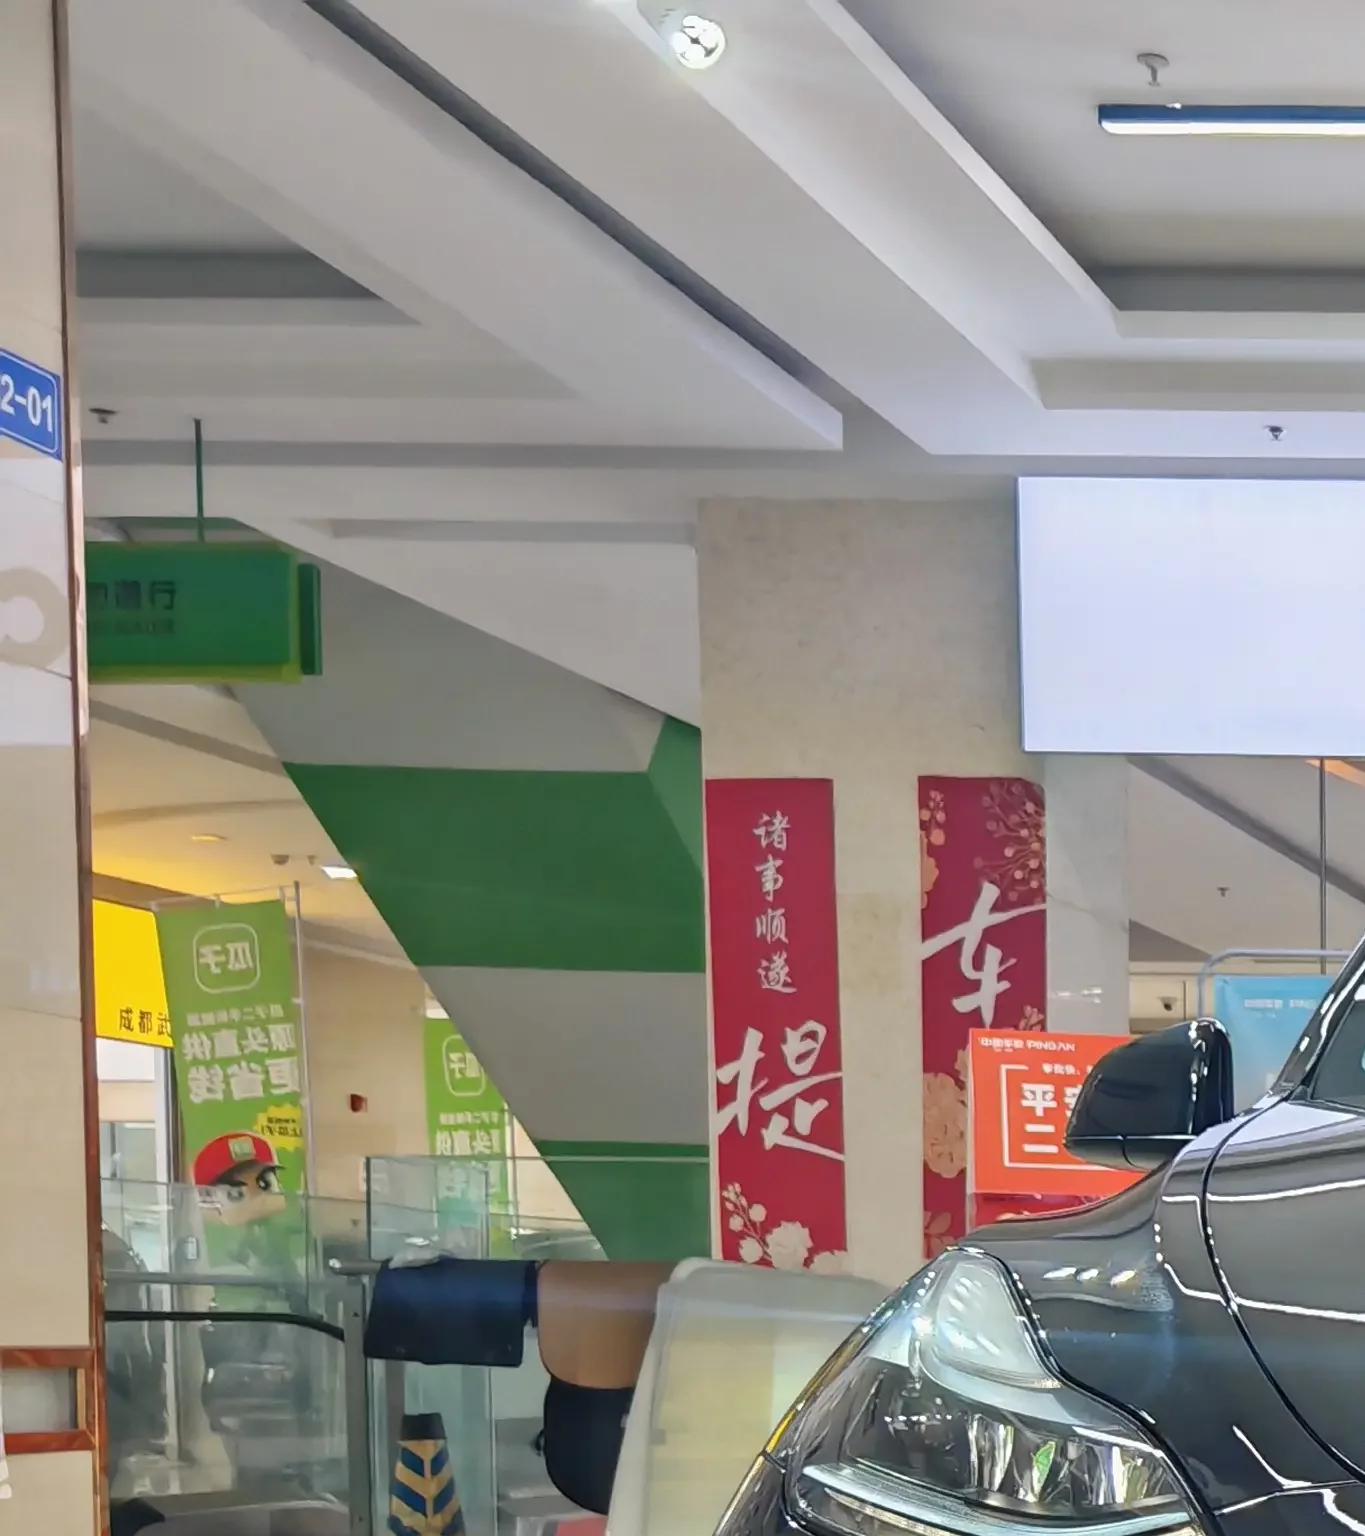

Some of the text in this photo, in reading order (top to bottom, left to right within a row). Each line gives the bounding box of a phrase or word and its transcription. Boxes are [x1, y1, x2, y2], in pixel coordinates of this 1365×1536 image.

[753, 810, 797, 995] 诸事顺遂
[921, 880, 1047, 1030] 车
[706, 1019, 845, 1163] 提
